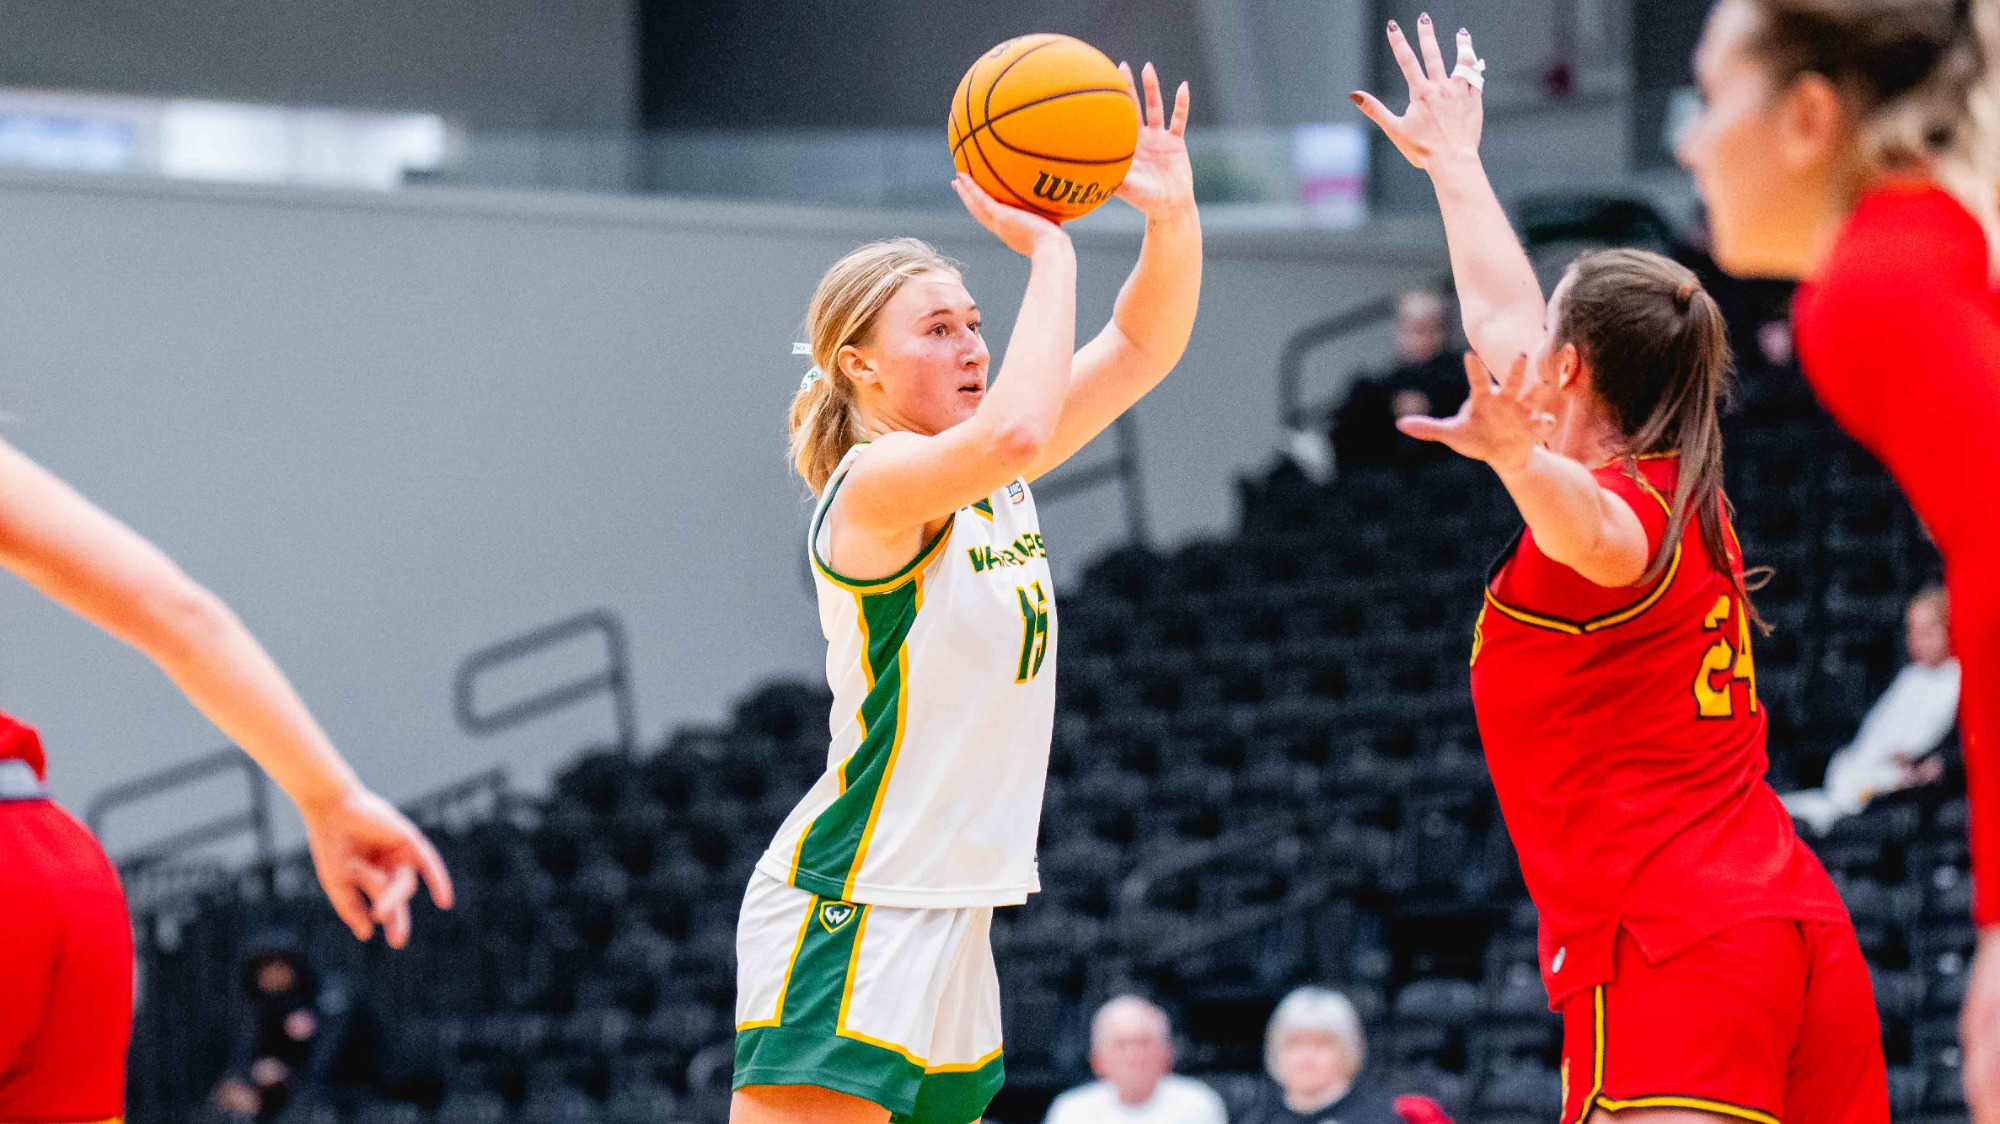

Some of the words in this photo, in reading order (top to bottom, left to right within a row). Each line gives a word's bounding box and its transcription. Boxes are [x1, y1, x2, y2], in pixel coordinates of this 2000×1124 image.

[1032, 170, 1121, 205] Wilso
[1015, 580, 1048, 684] 15
[1693, 593, 1757, 720] 24
